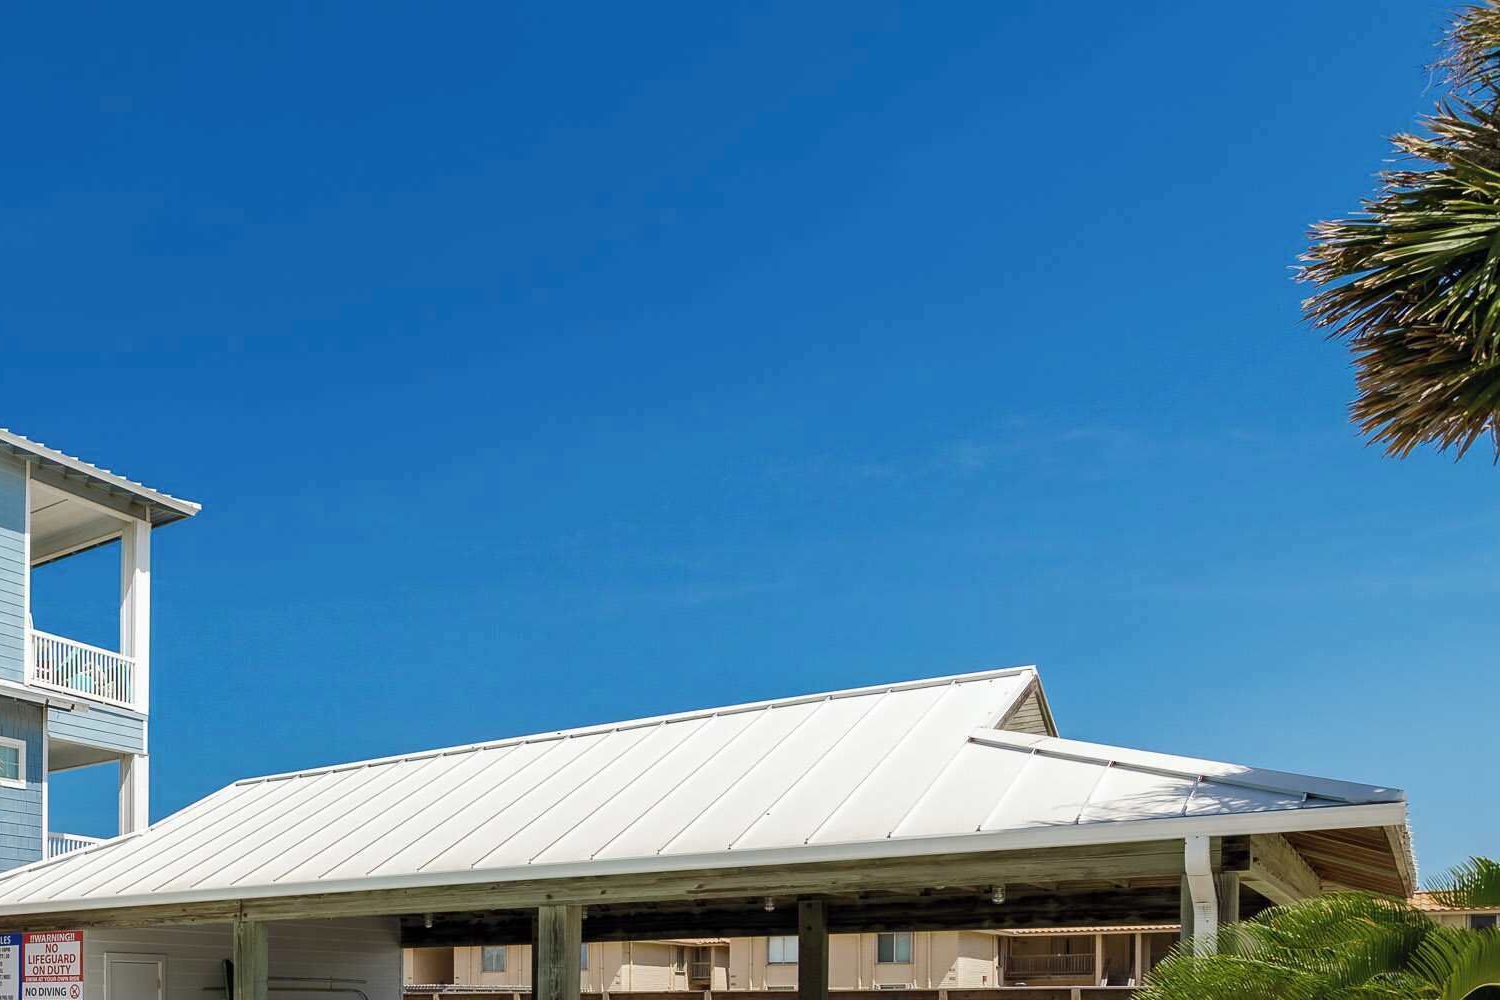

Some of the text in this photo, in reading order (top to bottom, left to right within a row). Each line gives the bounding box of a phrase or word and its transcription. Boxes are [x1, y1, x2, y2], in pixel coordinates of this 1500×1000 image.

[45, 943, 59, 953] NO
[28, 953, 76, 964] LIFEGUARD
[32, 964, 71, 975] ON DUTY
[25, 987, 67, 997] NO DIVING
